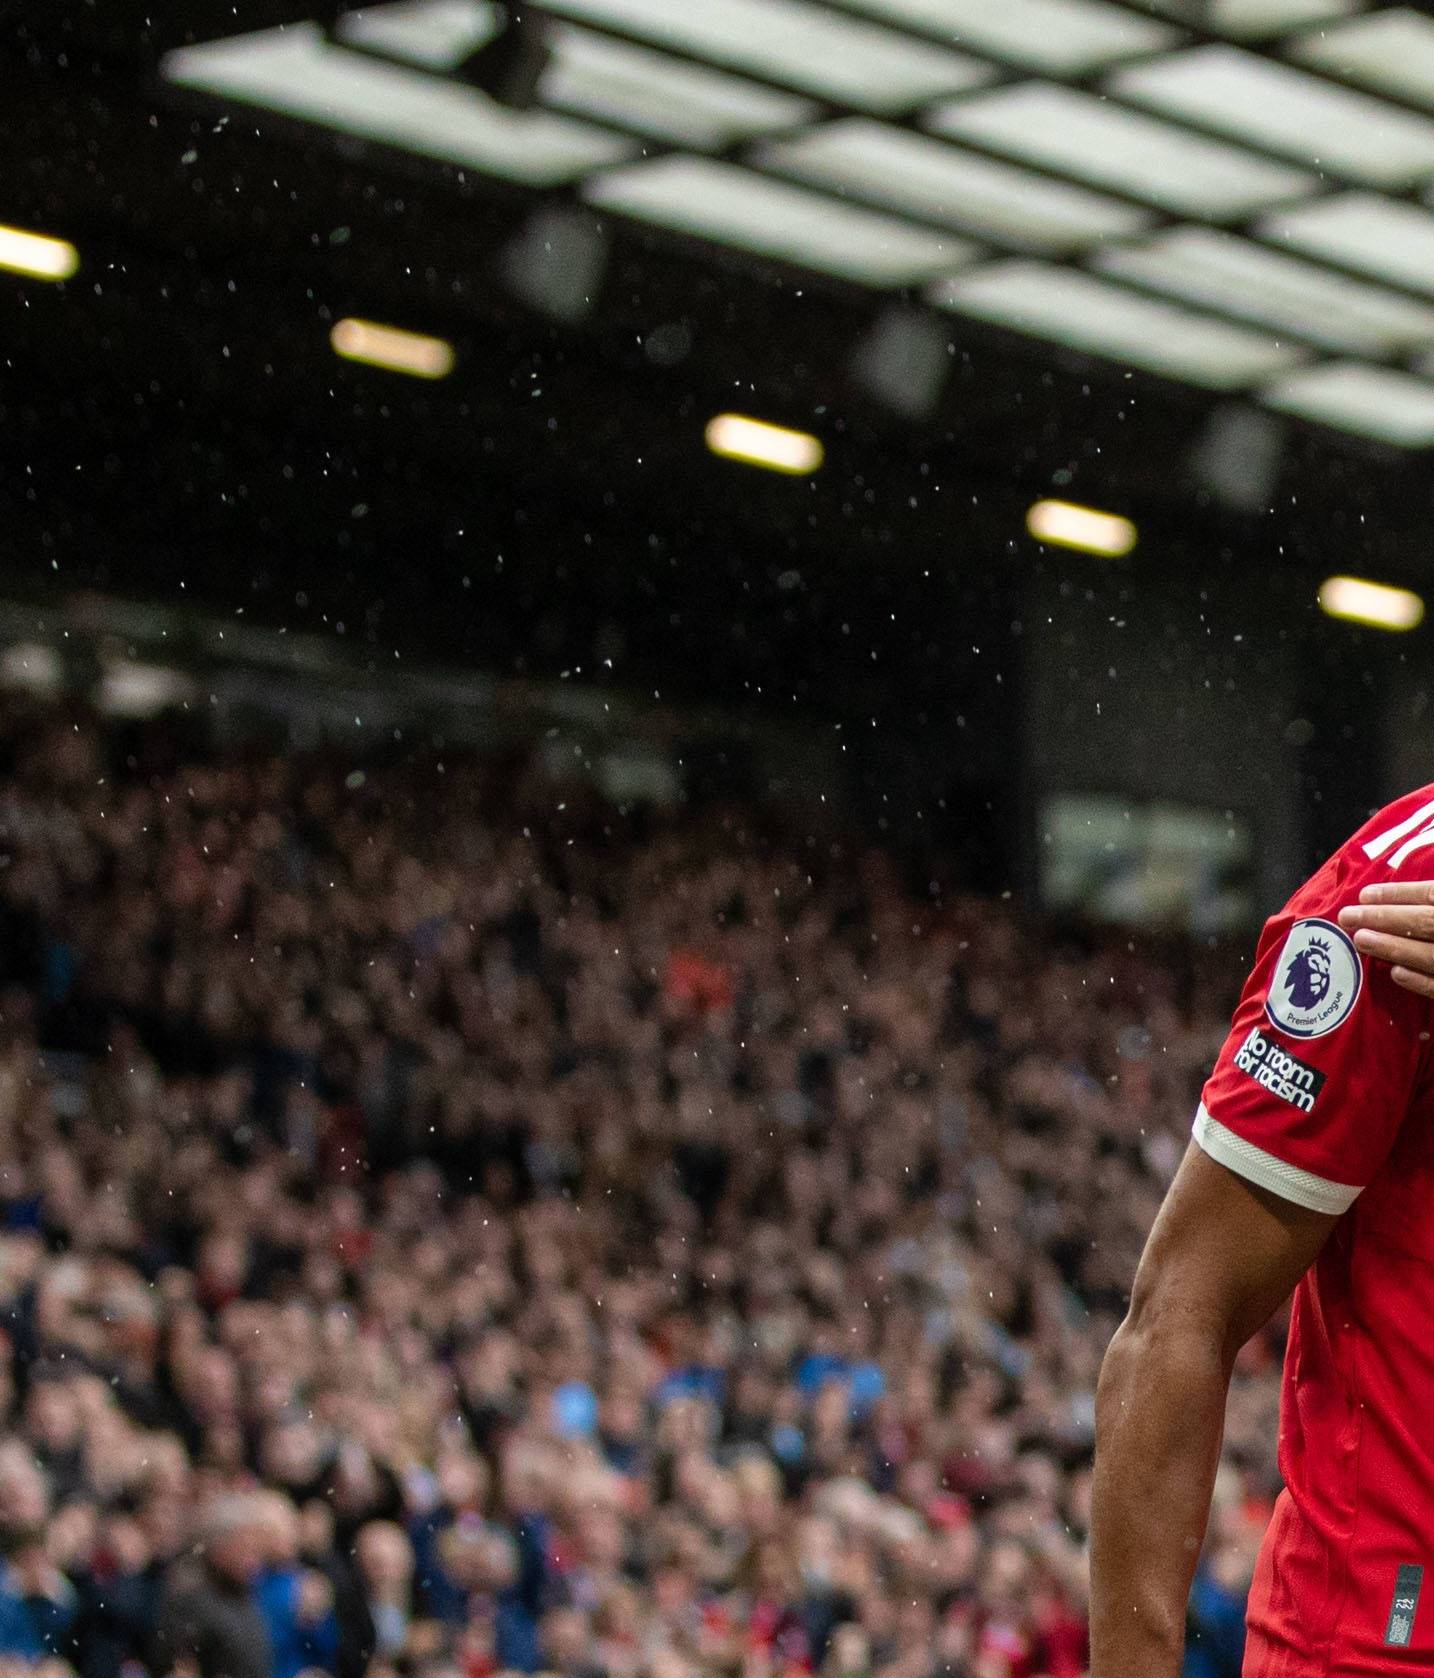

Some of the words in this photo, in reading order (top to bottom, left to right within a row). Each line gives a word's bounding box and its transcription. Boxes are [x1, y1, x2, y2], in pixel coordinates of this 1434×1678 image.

[1286, 1012, 1318, 1026] Premier
[1318, 990, 1343, 1021] League
[1233, 1045, 1260, 1074] for
[1253, 1063, 1315, 1113] racism
[1245, 1026, 1267, 1055] No
[1266, 1043, 1315, 1090] room
